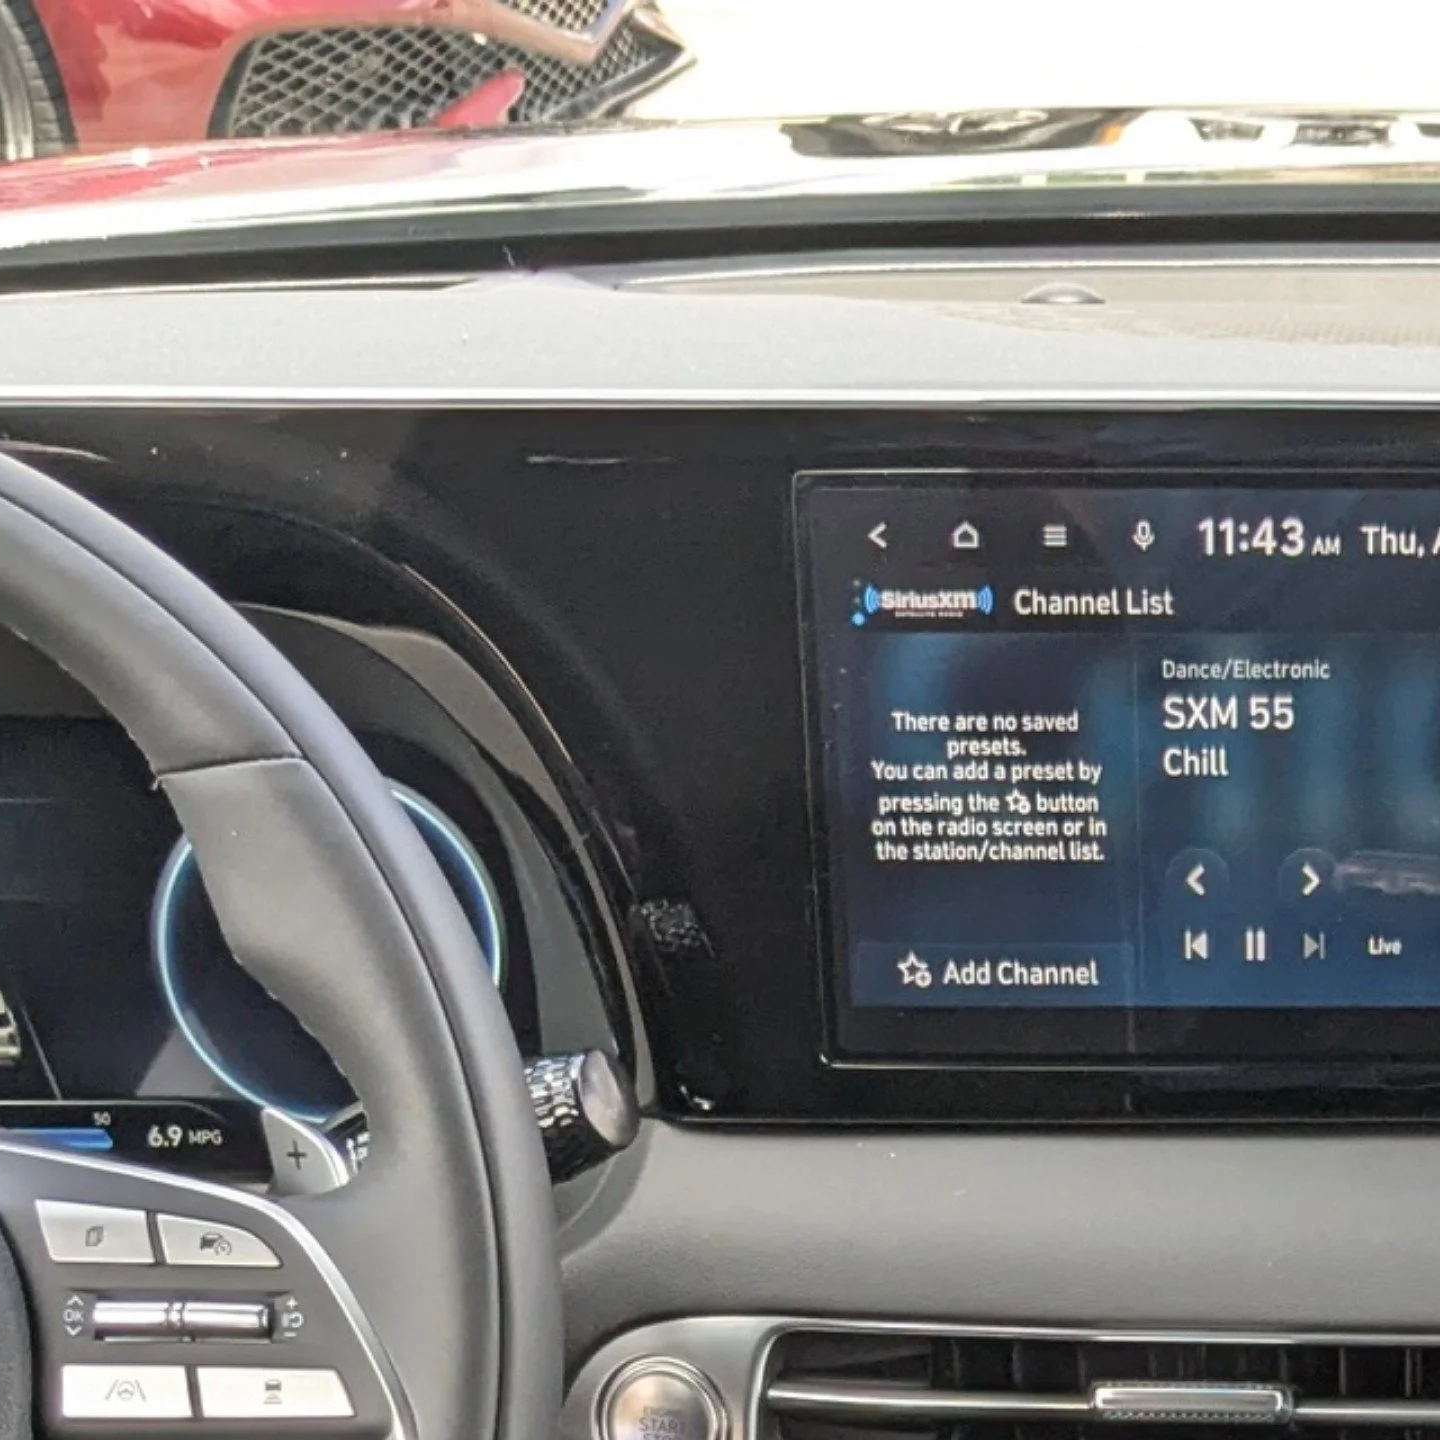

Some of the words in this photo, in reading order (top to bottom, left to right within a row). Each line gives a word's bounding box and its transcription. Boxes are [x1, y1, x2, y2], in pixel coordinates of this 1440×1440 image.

[1198, 517, 1304, 556] 11:43
[1312, 535, 1340, 556] AM
[1361, 524, 1423, 560] Thu,
[1014, 586, 1119, 615] Channel
[1127, 586, 1174, 615] List
[1162, 658, 1330, 681] Dance/Electronic
[891, 711, 950, 732] There
[955, 715, 988, 732] are
[993, 715, 1017, 732] no
[1022, 711, 1079, 732] saved
[1163, 697, 1238, 731] SXM
[1248, 697, 1294, 730] 55
[946, 737, 1027, 759] presets.
[871, 760, 908, 781] You
[913, 765, 948, 781] can
[953, 760, 988, 781] add
[994, 765, 1006, 781] a
[1012, 762, 1075, 784] preset
[1078, 761, 1102, 784] by
[1163, 747, 1228, 778] Chill
[879, 792, 963, 815] pressing
[968, 793, 1000, 812] the
[1037, 793, 1099, 813] button
[871, 819, 896, 836] on
[901, 817, 932, 836] the
[938, 817, 988, 836] radio
[992, 820, 1058, 836] screen
[1063, 820, 1083, 836] or
[1089, 818, 1107, 836] in
[876, 841, 909, 861] the
[913, 841, 1065, 862] station/channel
[1070, 841, 1105, 861] list.
[1369, 937, 1402, 957] Live
[943, 961, 990, 986] Add
[997, 960, 1099, 987] Channel
[92, 1112, 111, 1126] 50
[147, 1125, 183, 1147] 6.9
[189, 1130, 223, 1145] MPG
